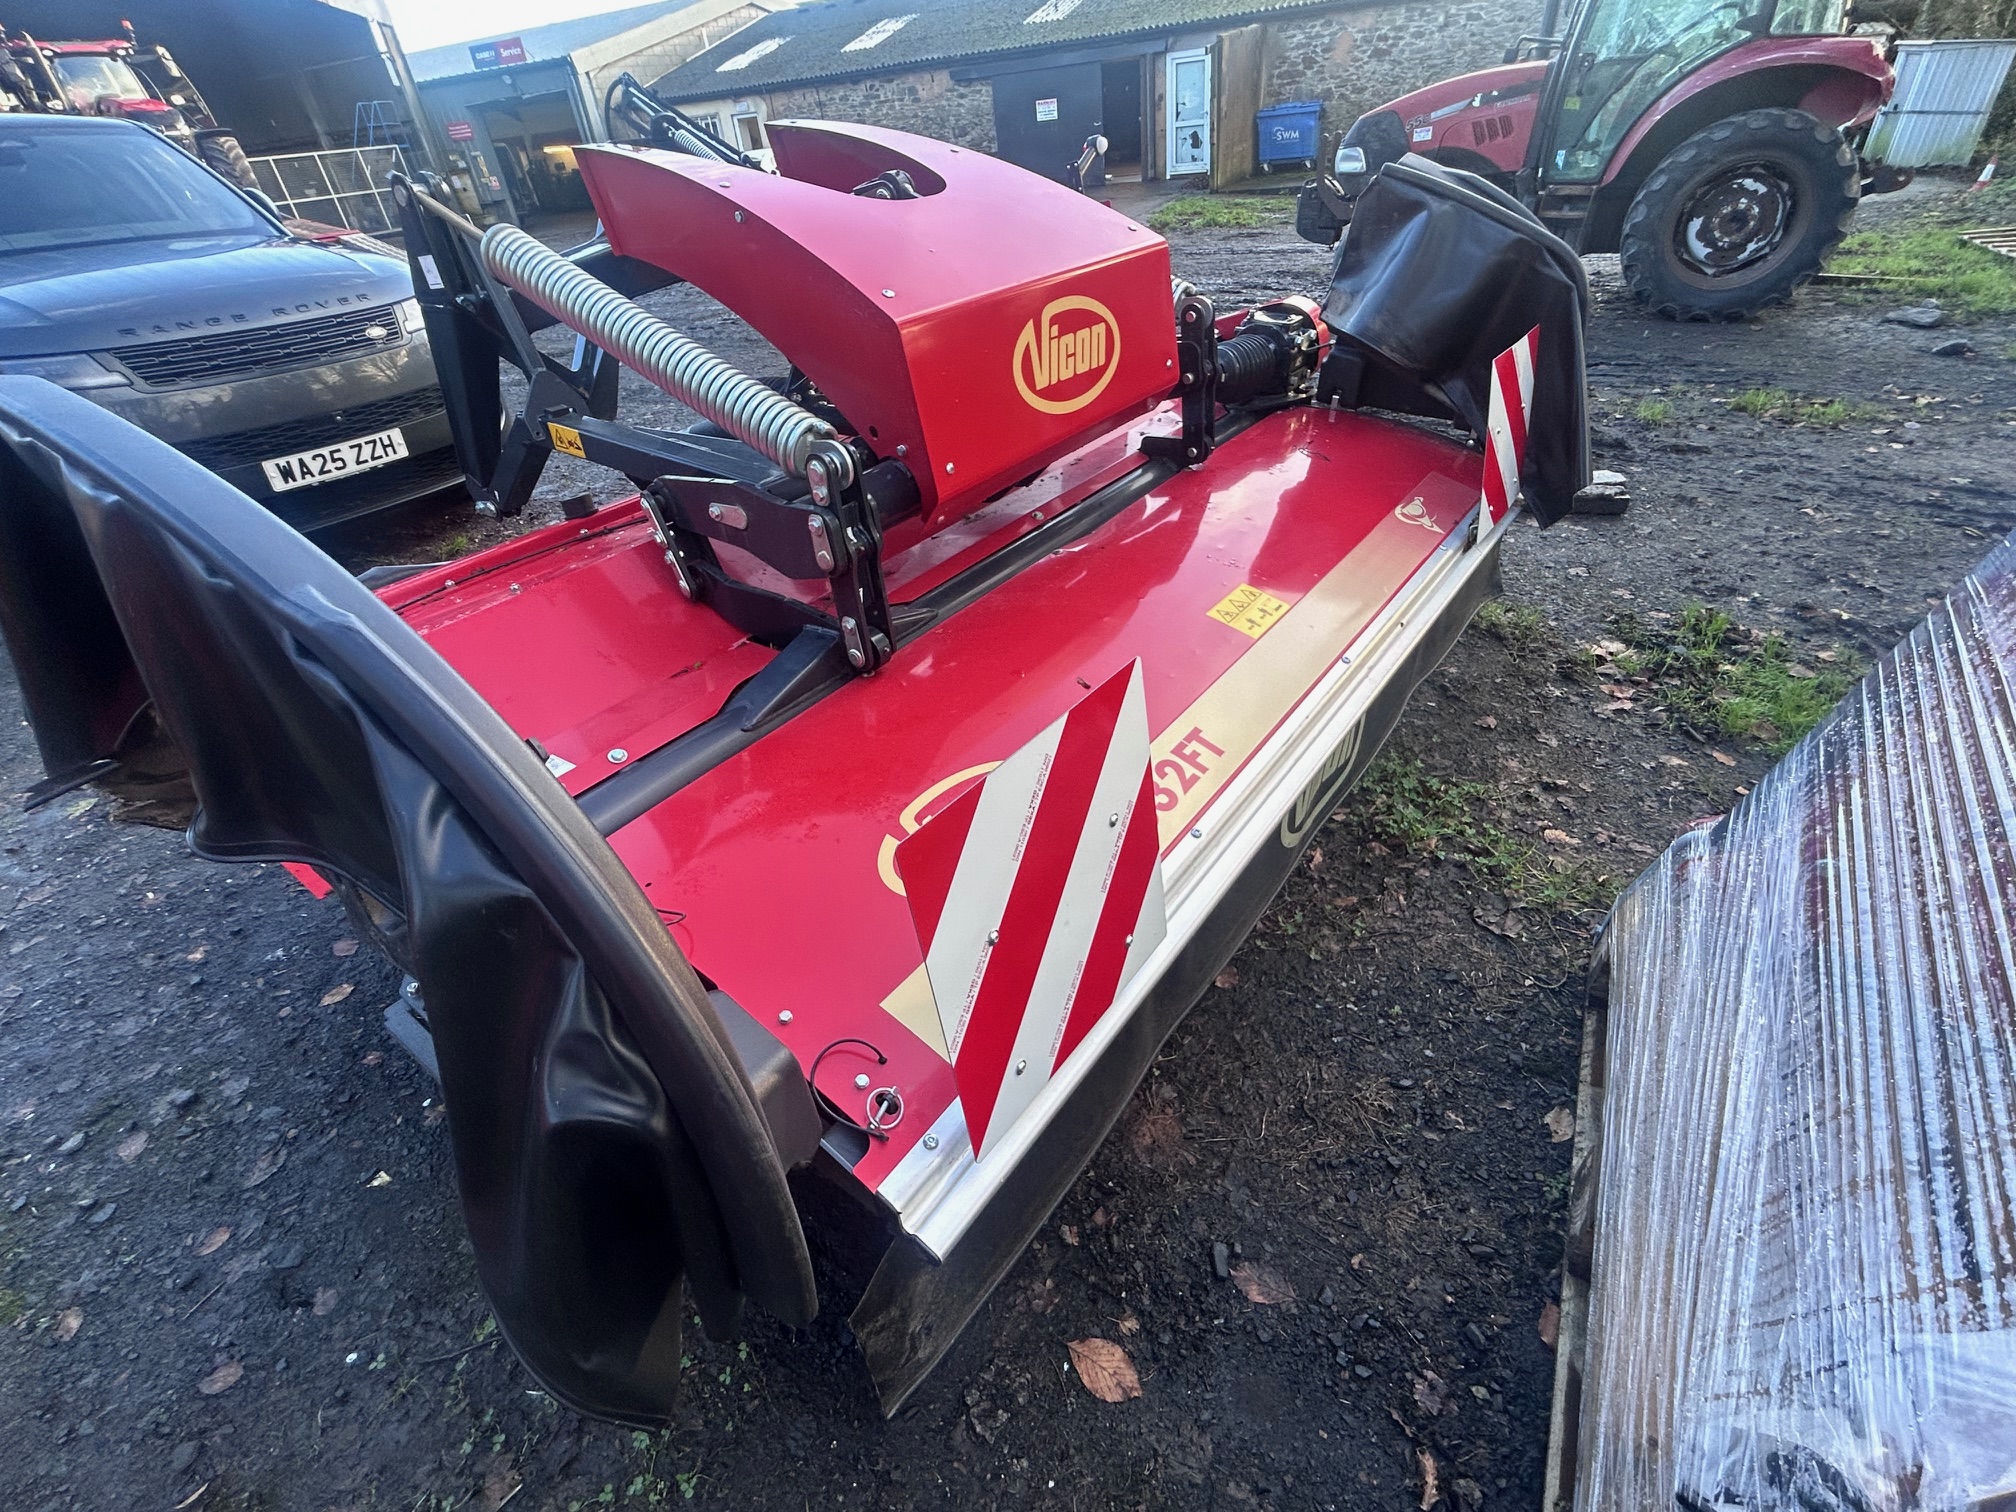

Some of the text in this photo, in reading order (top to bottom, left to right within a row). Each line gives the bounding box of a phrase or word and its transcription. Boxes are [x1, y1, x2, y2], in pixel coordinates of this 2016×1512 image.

[500, 47, 522, 57] Service
[1276, 130, 1299, 141] SWM
[117, 293, 371, 337] RANGE ROVER
[1027, 303, 1107, 392] Vicon
[274, 434, 398, 485] WA25 ZZH
